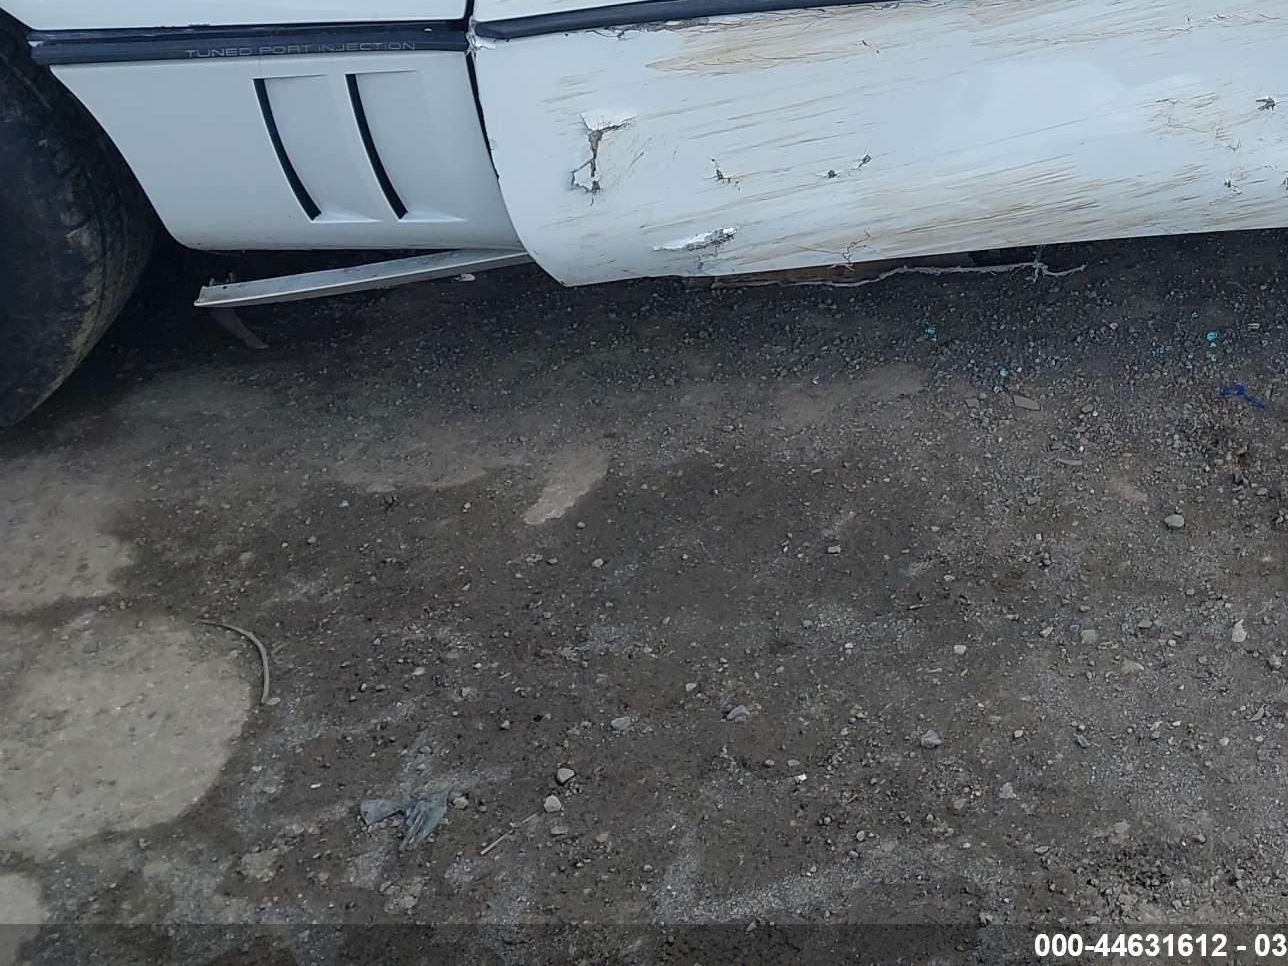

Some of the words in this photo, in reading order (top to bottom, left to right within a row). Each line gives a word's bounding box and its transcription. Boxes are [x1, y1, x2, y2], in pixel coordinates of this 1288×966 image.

[186, 48, 252, 57] TUNED
[258, 44, 312, 54] PORT
[318, 41, 416, 51] INJECTION
